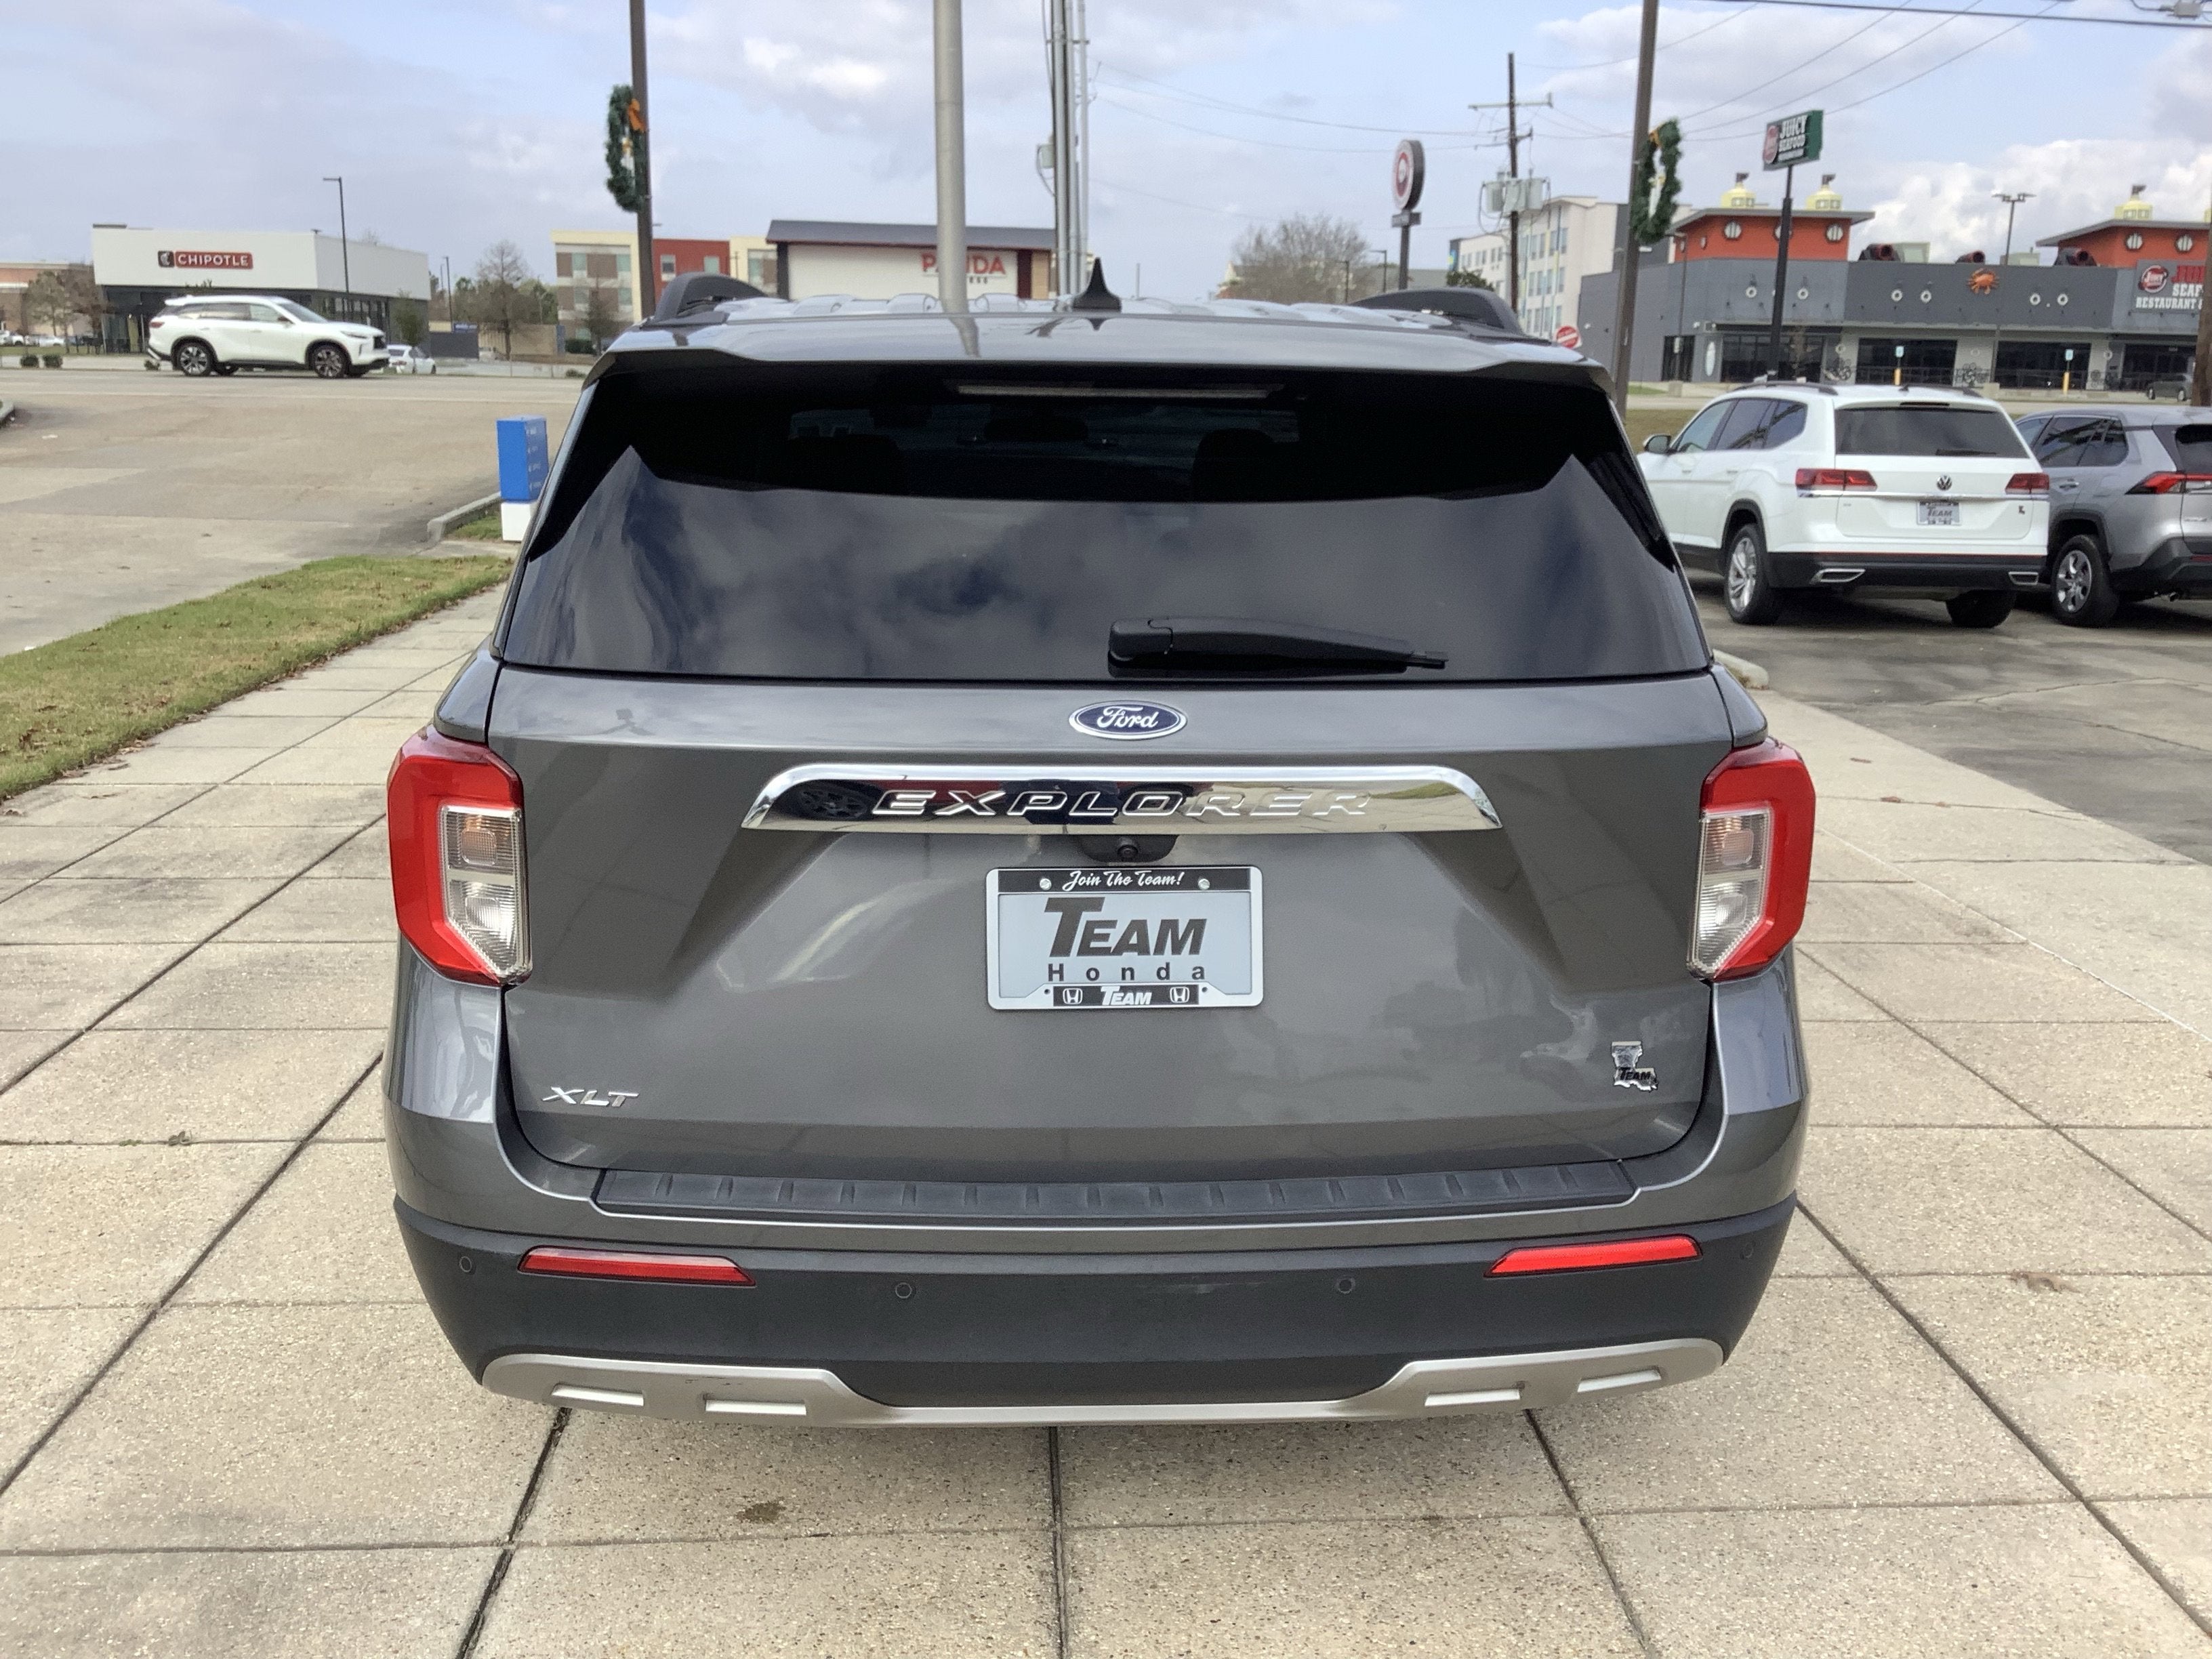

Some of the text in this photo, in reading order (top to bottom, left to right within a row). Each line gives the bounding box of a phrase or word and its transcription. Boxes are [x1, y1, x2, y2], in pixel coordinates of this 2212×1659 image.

[178, 253, 249, 266] CHIPOTLE
[922, 253, 1006, 274] PDA
[2135, 296, 2196, 310] RESTAURANT
[1097, 705, 1159, 729] Ford
[871, 789, 1374, 817] EXPLORER
[1062, 870, 1185, 892] Join The Team!
[1044, 896, 1207, 958] TEAM
[1048, 962, 1206, 982] Honda
[1101, 985, 1152, 1006] TEAM
[542, 1086, 639, 1107] XLT
